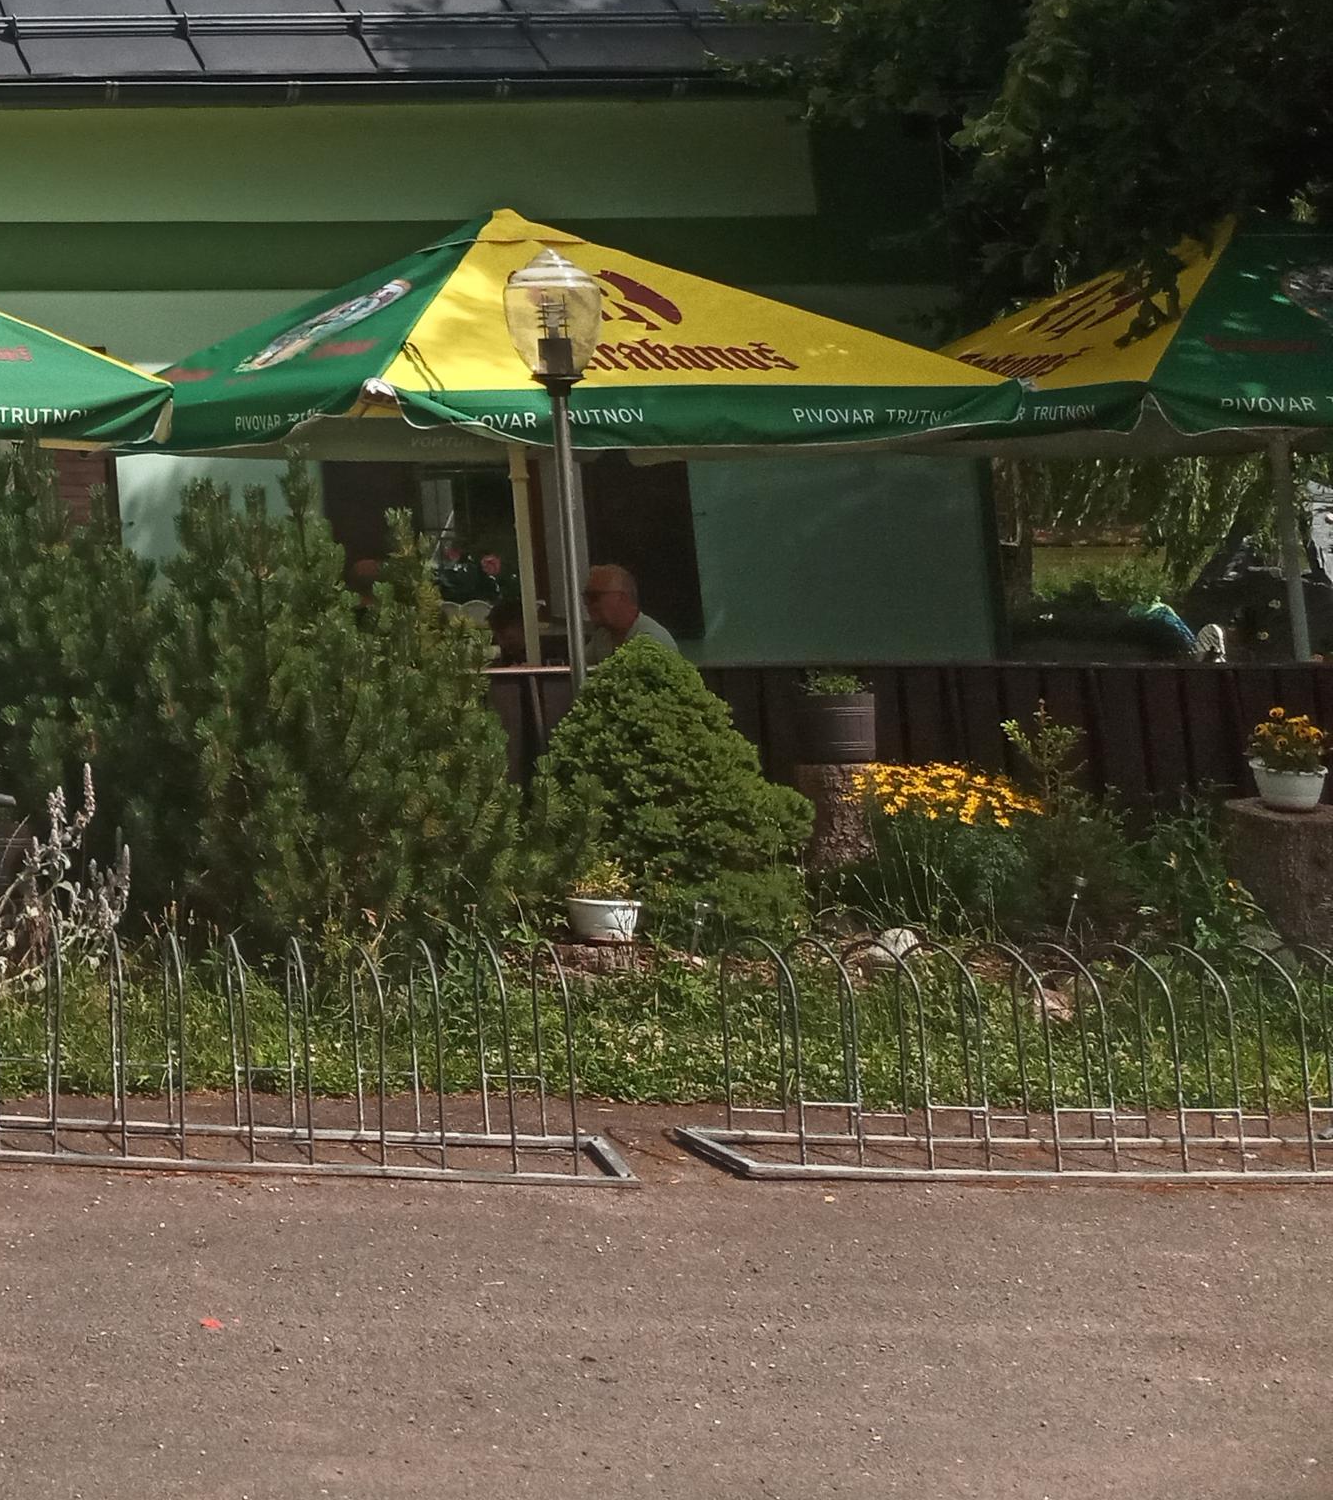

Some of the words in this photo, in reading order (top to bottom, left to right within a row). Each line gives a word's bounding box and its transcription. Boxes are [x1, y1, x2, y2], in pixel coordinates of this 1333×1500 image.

[1220, 397, 1317, 413] PIVOVAR
[235, 414, 281, 431] PIVOVAR
[476, 412, 537, 428] OVAR
[549, 408, 644, 425] RUTNOV
[792, 408, 875, 424] PIVOVAR
[885, 409, 953, 426] TRUTNO
